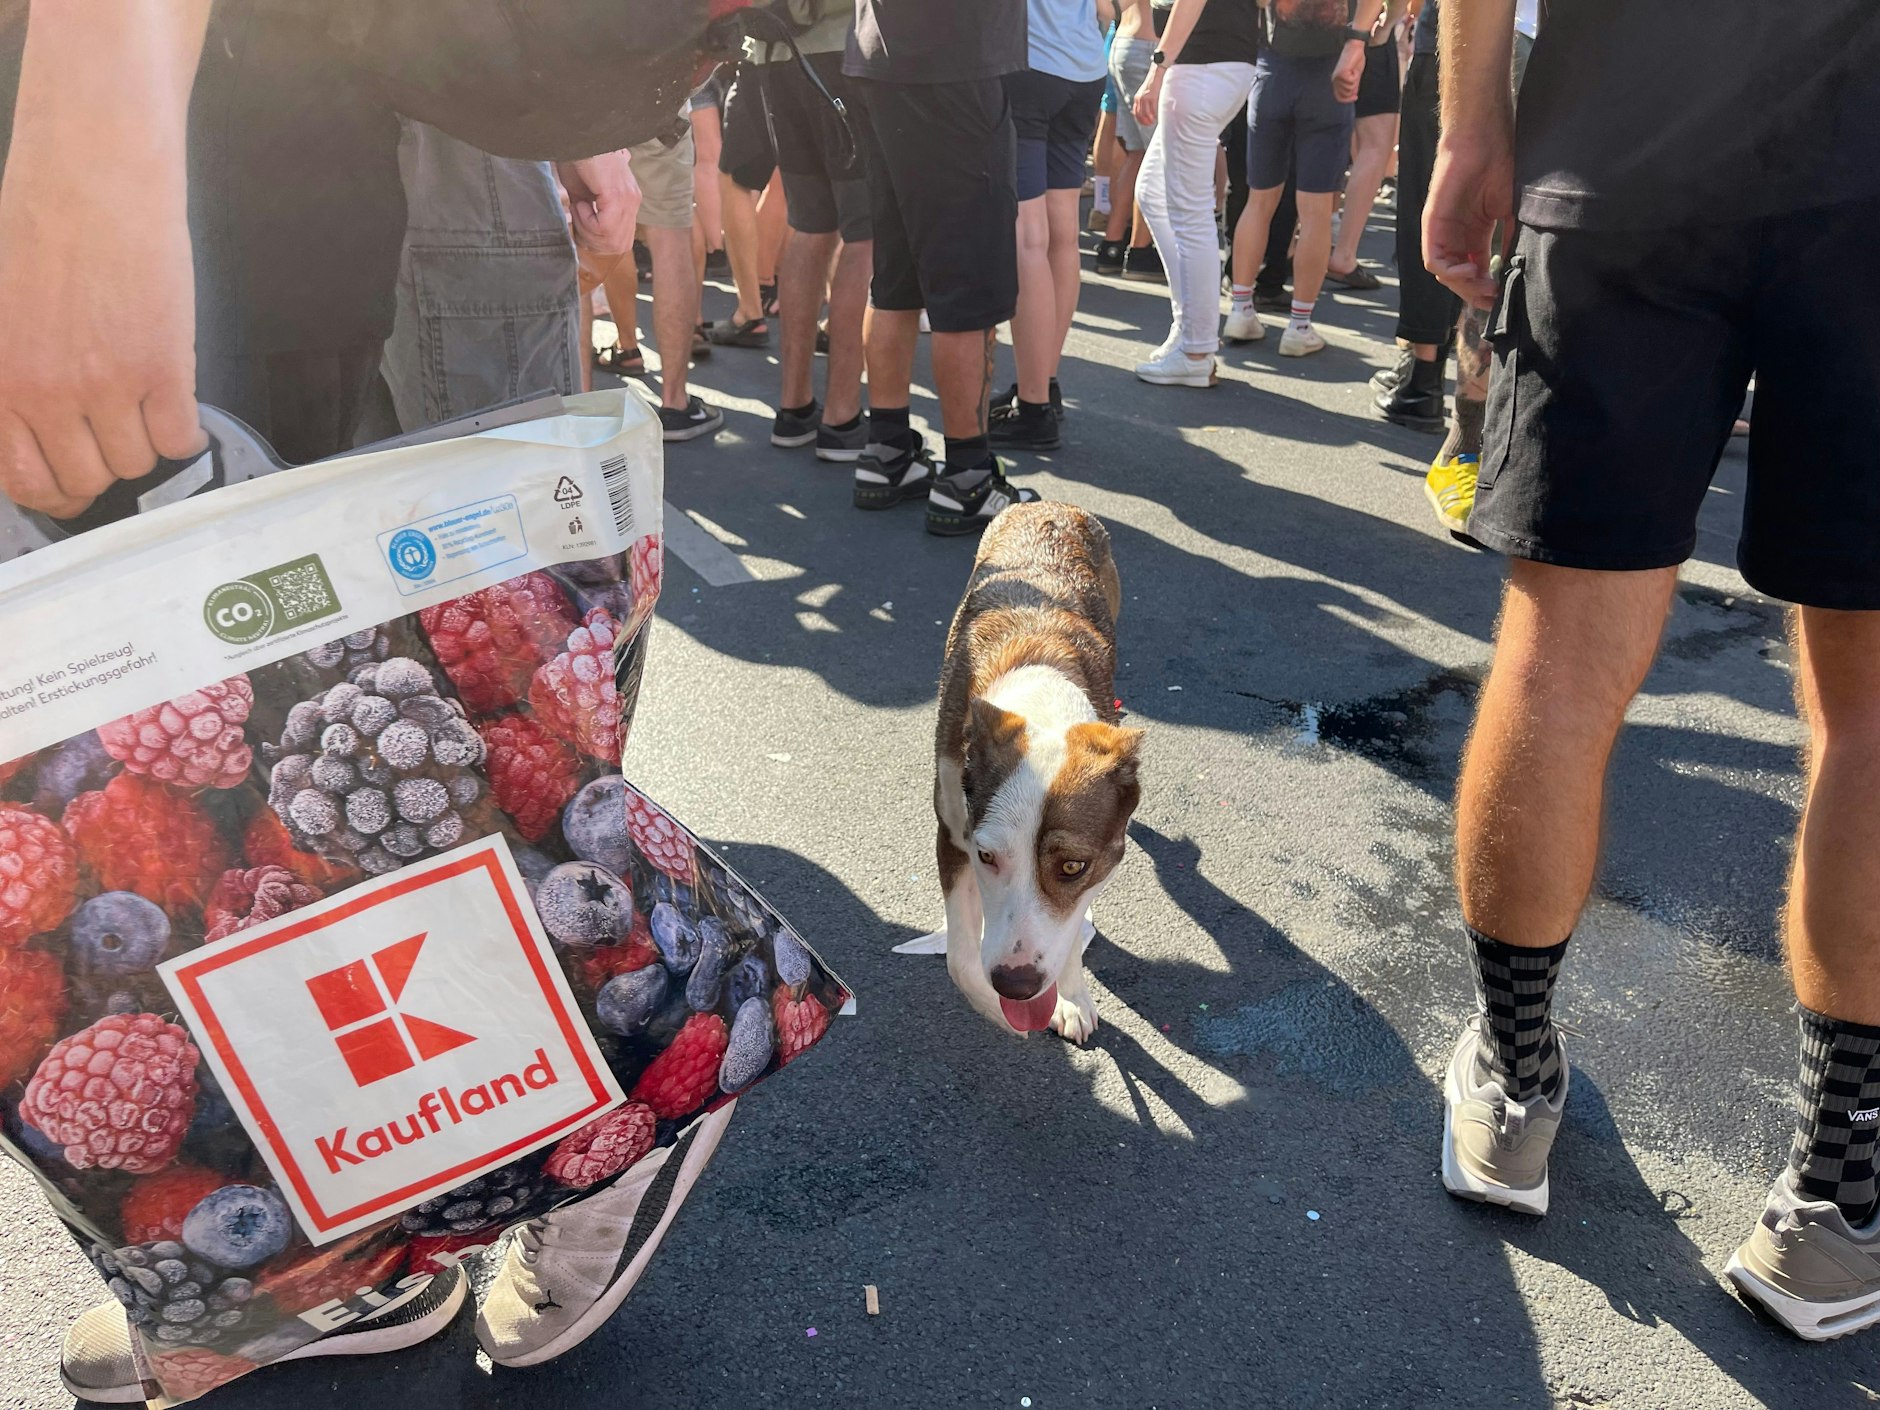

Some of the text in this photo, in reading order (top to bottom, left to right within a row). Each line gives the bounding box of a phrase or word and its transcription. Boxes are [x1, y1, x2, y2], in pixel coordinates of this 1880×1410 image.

[561, 501, 581, 510] LDPE
[562, 487, 573, 495] 04
[0, 642, 135, 701] tung! Kein Spielzeug!
[0, 651, 158, 720] alten! Erstickungsgefahr!
[314, 1048, 559, 1174] Kaufland
[1847, 1107, 1880, 1122] VANS
